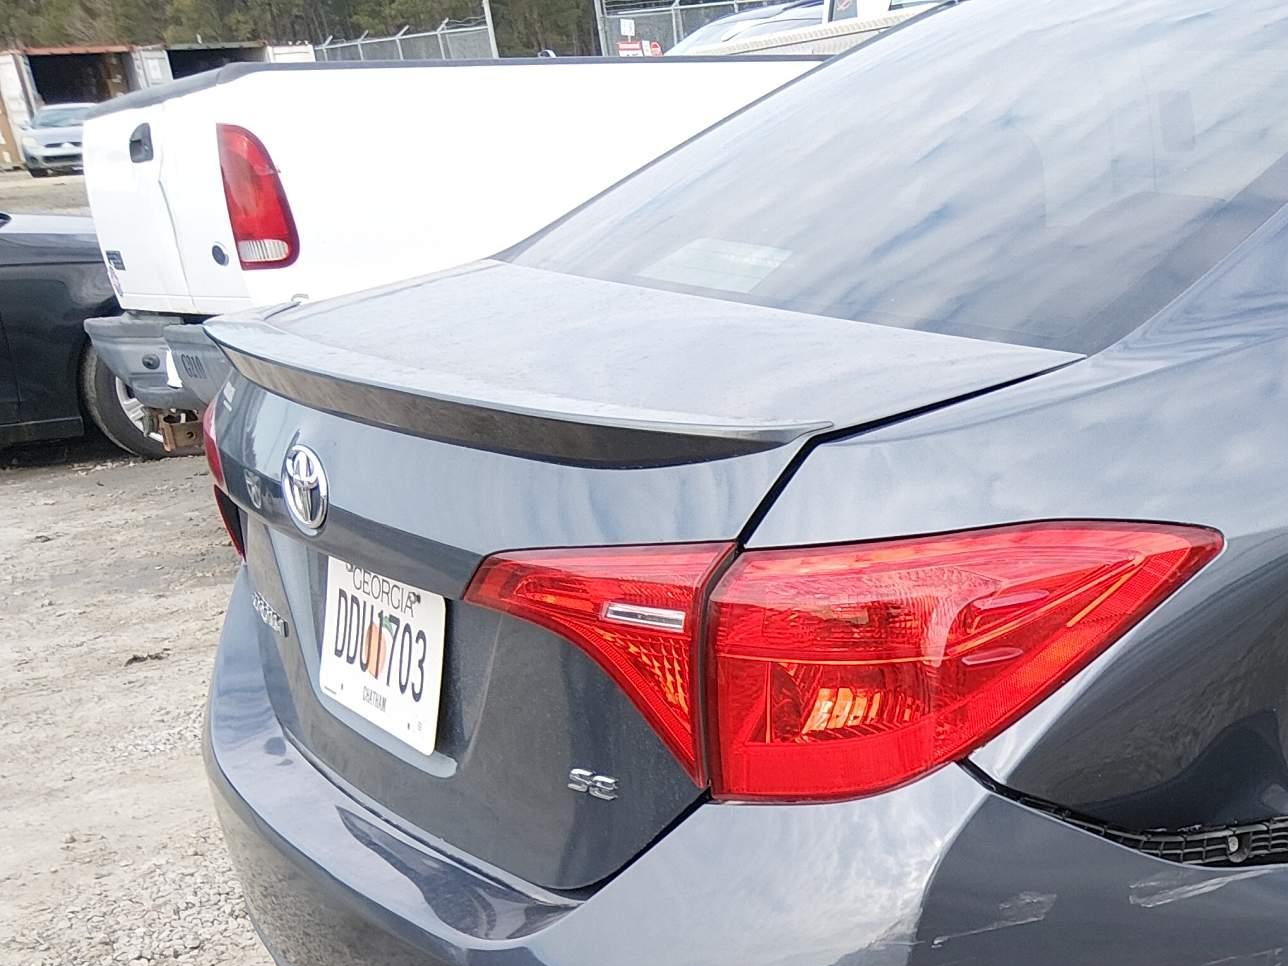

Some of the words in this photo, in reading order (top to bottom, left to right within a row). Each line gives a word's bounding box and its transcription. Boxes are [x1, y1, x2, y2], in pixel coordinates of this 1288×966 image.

[352, 567, 415, 618] GEORGIA
[334, 588, 427, 702] DDU1703
[568, 768, 618, 800] SE
